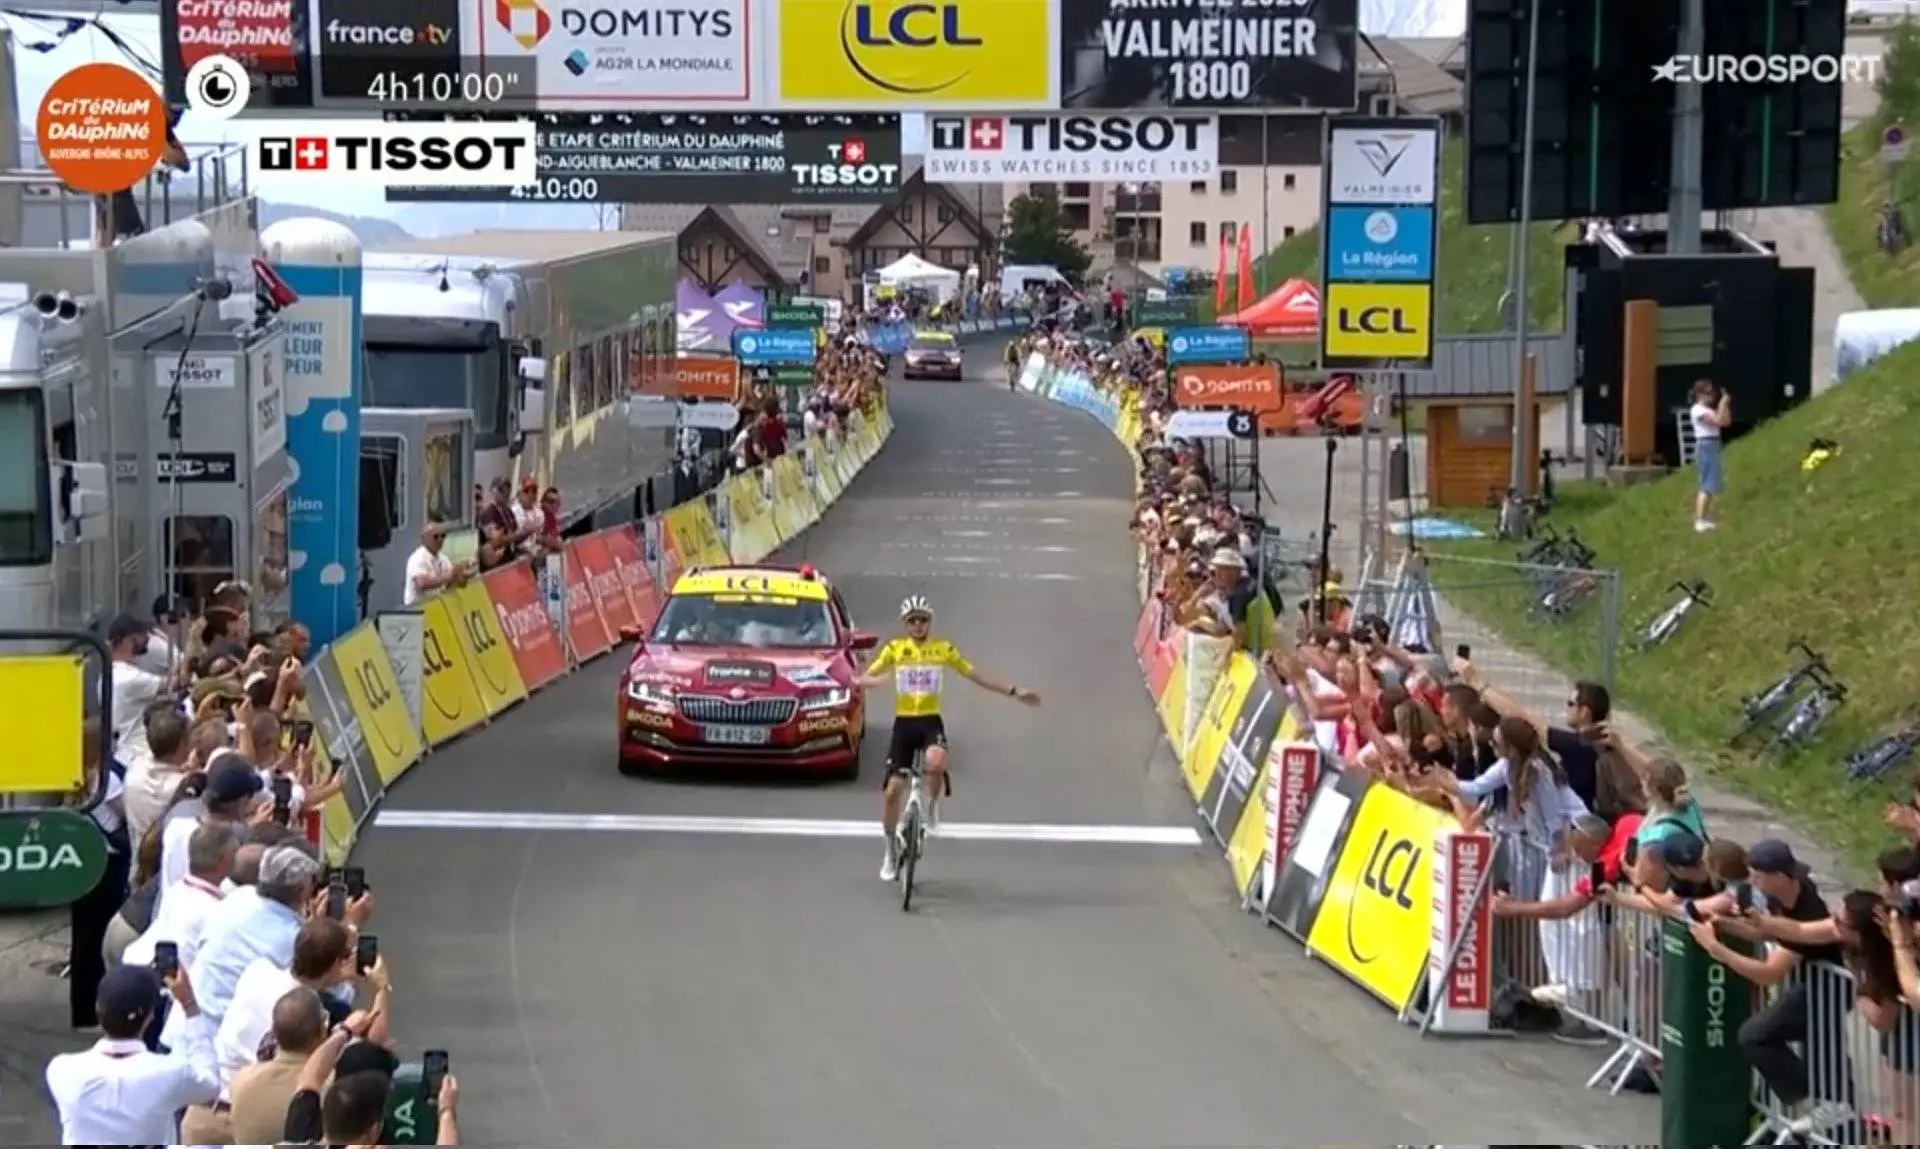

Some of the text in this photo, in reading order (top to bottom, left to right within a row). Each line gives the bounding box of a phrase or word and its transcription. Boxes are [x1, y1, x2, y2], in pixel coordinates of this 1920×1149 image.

[561, 9, 732, 38] DOMITYS
[856, 3, 983, 46] LCL
[1102, 19, 1316, 58] VALMEINIER
[638, 57, 656, 72] LA
[660, 57, 733, 72] MONDIALE
[1170, 62, 1250, 99] 1800
[599, 130, 681, 149] CRITÉRIUM
[684, 132, 704, 149] DU
[709, 129, 785, 149] DAUPHINÉ
[1010, 117, 1210, 151] TISSOT
[674, 154, 751, 171] VALMEINIER
[755, 155, 785, 172] 1800
[791, 164, 898, 185] TISSOT
[931, 159, 993, 175] SWISS
[1003, 159, 1092, 175] WATCHES
[1101, 159, 1159, 175] SINCE
[1338, 307, 1417, 334] LCL
[1363, 828, 1424, 911] LCL
